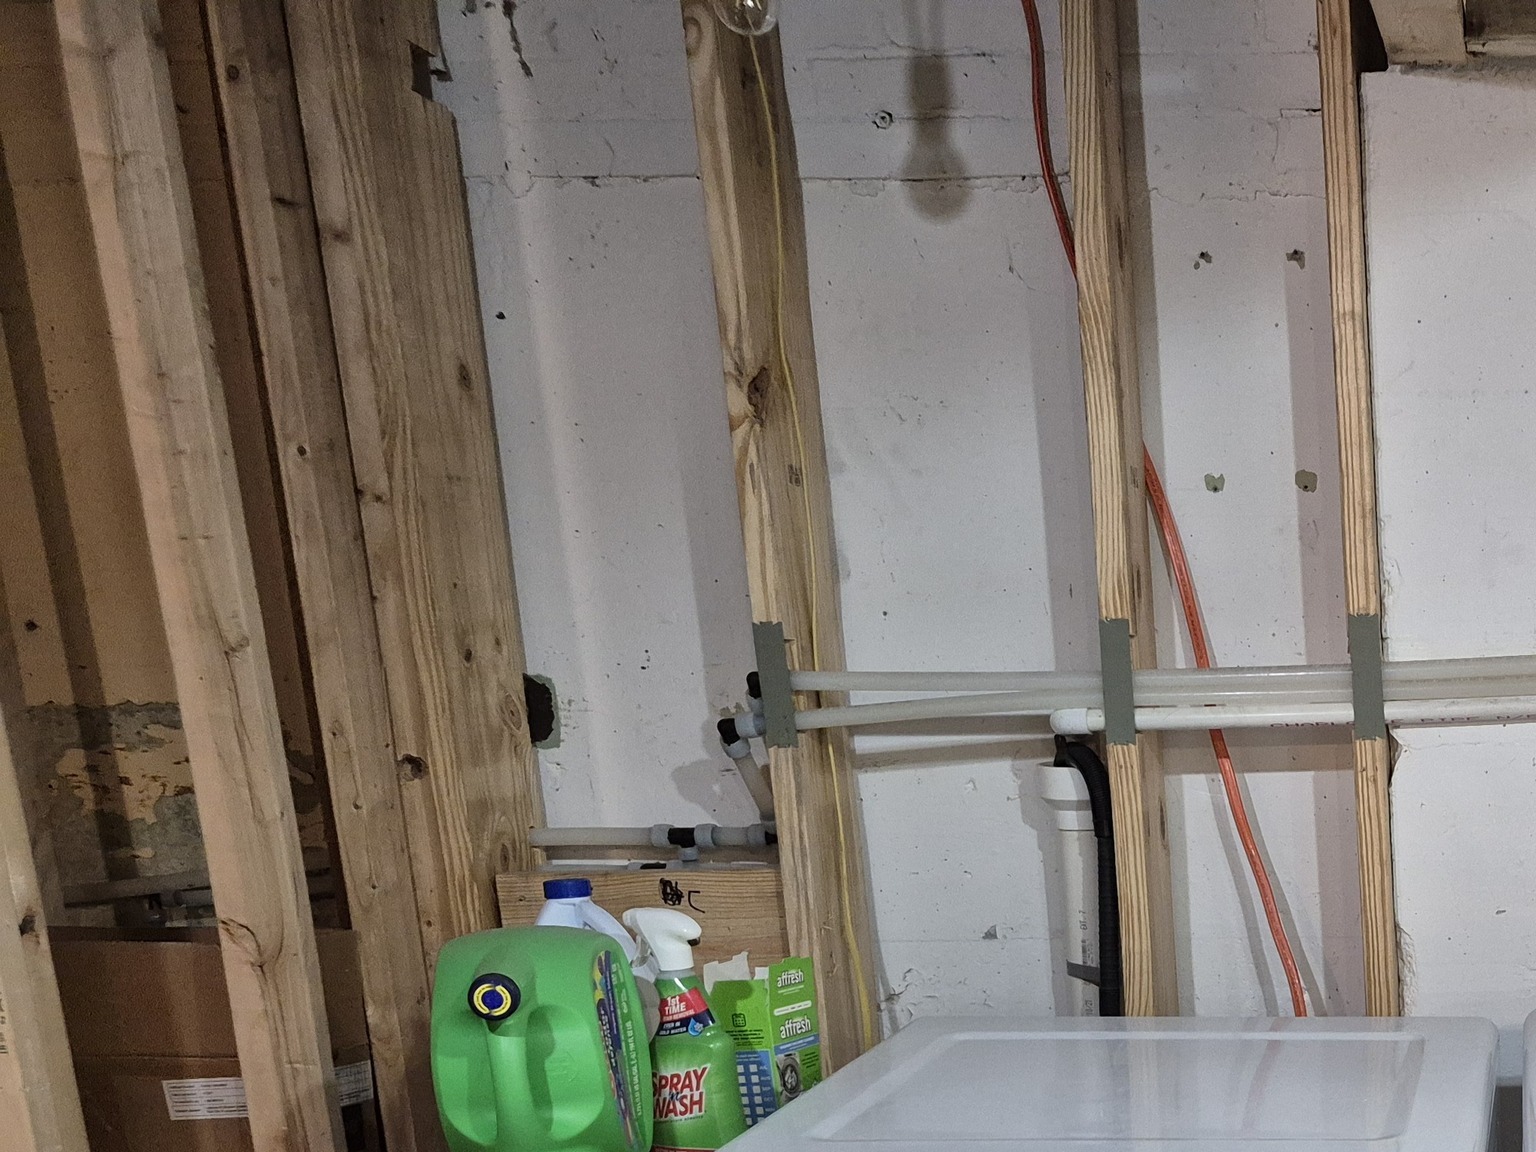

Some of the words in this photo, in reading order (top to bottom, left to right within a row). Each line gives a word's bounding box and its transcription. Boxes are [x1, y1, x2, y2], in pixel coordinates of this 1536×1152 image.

[777, 968, 804, 988] affresh
[665, 1002, 686, 1015] TIME
[667, 995, 680, 1006] 1st
[780, 1015, 811, 1038] affresh
[652, 1066, 708, 1097] SPRAY
[653, 1092, 703, 1119] WASH
